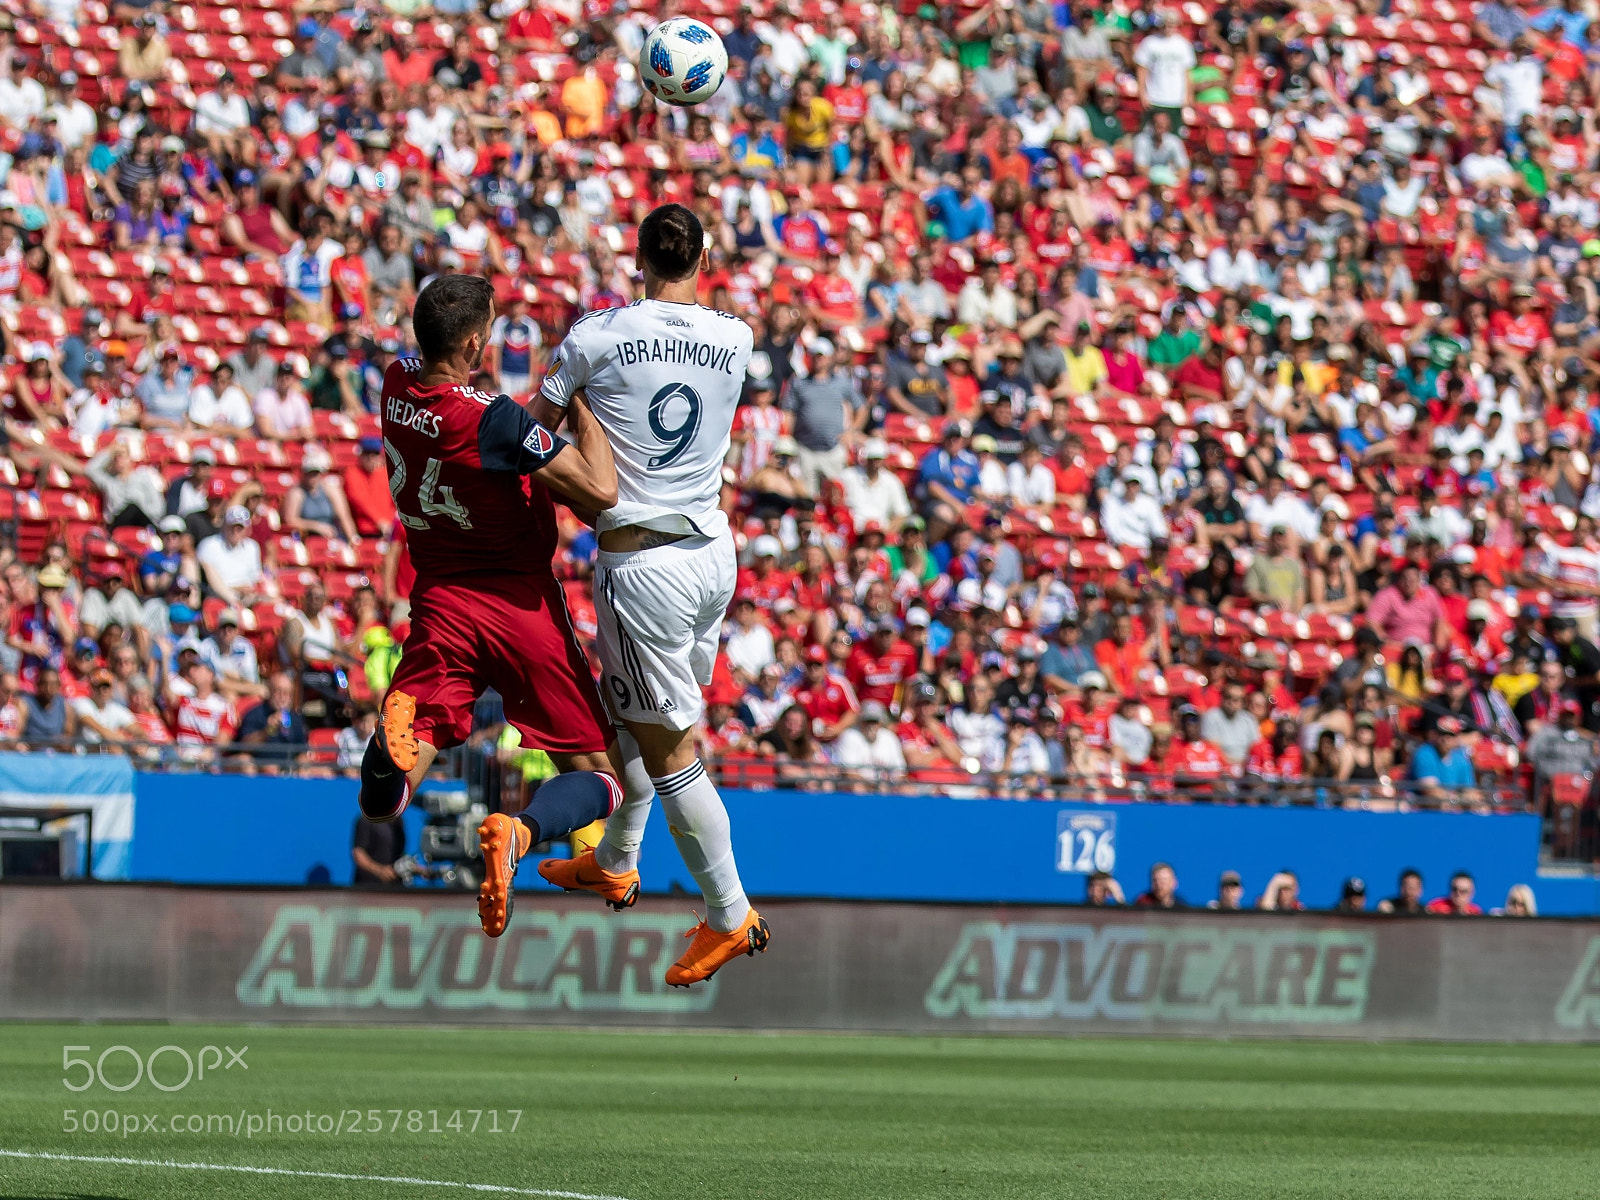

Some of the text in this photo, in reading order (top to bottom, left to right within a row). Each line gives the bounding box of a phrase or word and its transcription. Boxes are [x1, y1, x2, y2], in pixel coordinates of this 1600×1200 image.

[616, 338, 738, 375] IBRAHIMOVIĆ
[386, 396, 443, 439] HEDGES
[646, 382, 703, 471] 9
[384, 436, 475, 531] 24
[610, 674, 632, 710] 9
[1057, 829, 1116, 873] 126
[932, 926, 1371, 1015] ADVOCARE
